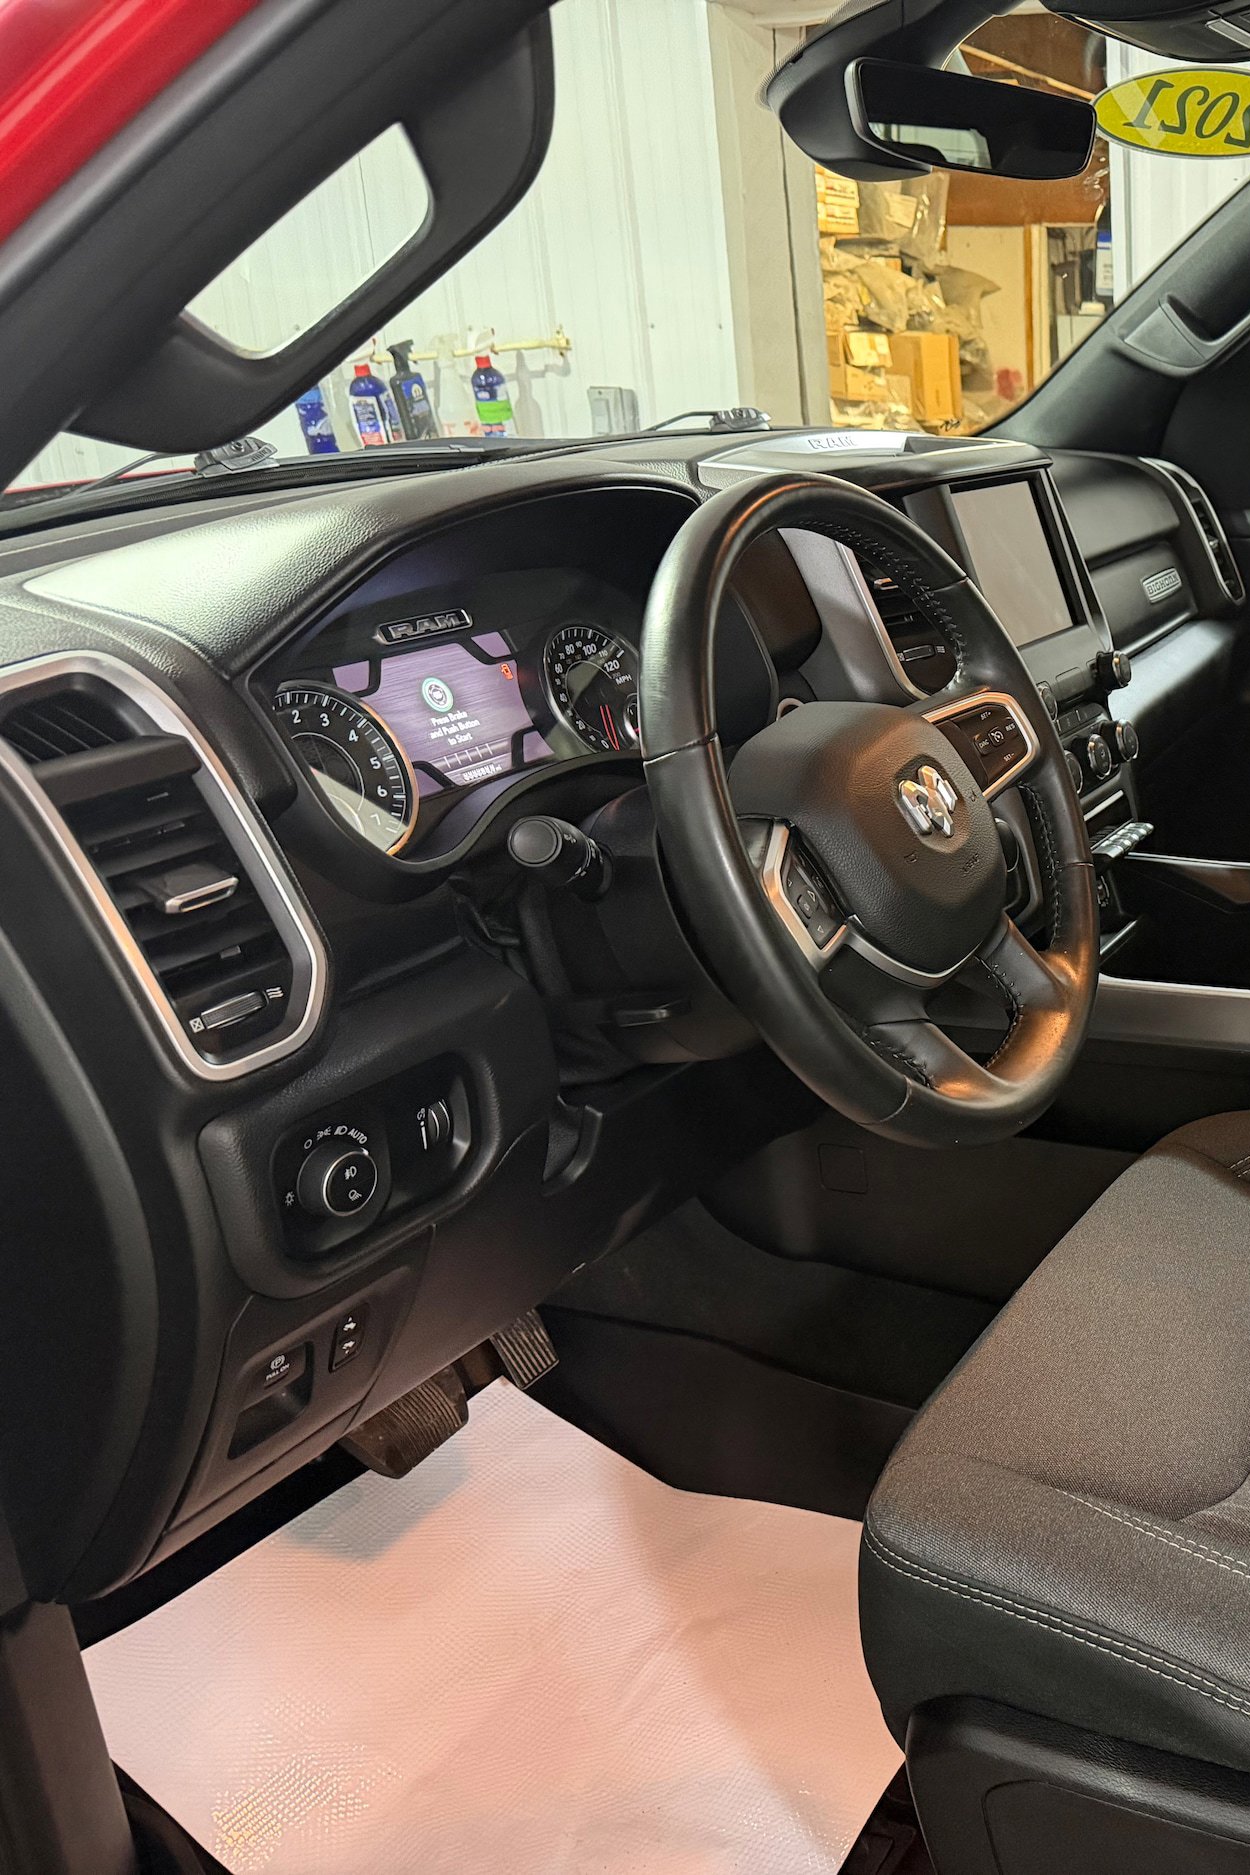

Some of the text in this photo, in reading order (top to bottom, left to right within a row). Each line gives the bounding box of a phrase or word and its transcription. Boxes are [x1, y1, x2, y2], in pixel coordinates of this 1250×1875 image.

[1146, 573, 1180, 595] BIGHORN
[388, 613, 461, 640] RAM
[565, 644, 575, 655] 80
[582, 643, 597, 656] 100
[603, 660, 620, 673] 120
[615, 674, 632, 685] MPH
[291, 709, 301, 724] 2
[319, 713, 330, 727] 3
[458, 719, 481, 731] Button
[348, 729, 359, 742] 4
[455, 732, 473, 744] Start
[369, 756, 381, 770] 5
[376, 785, 388, 797] 6
[370, 813, 381, 826] 7
[347, 1127, 368, 1145] AUTO
